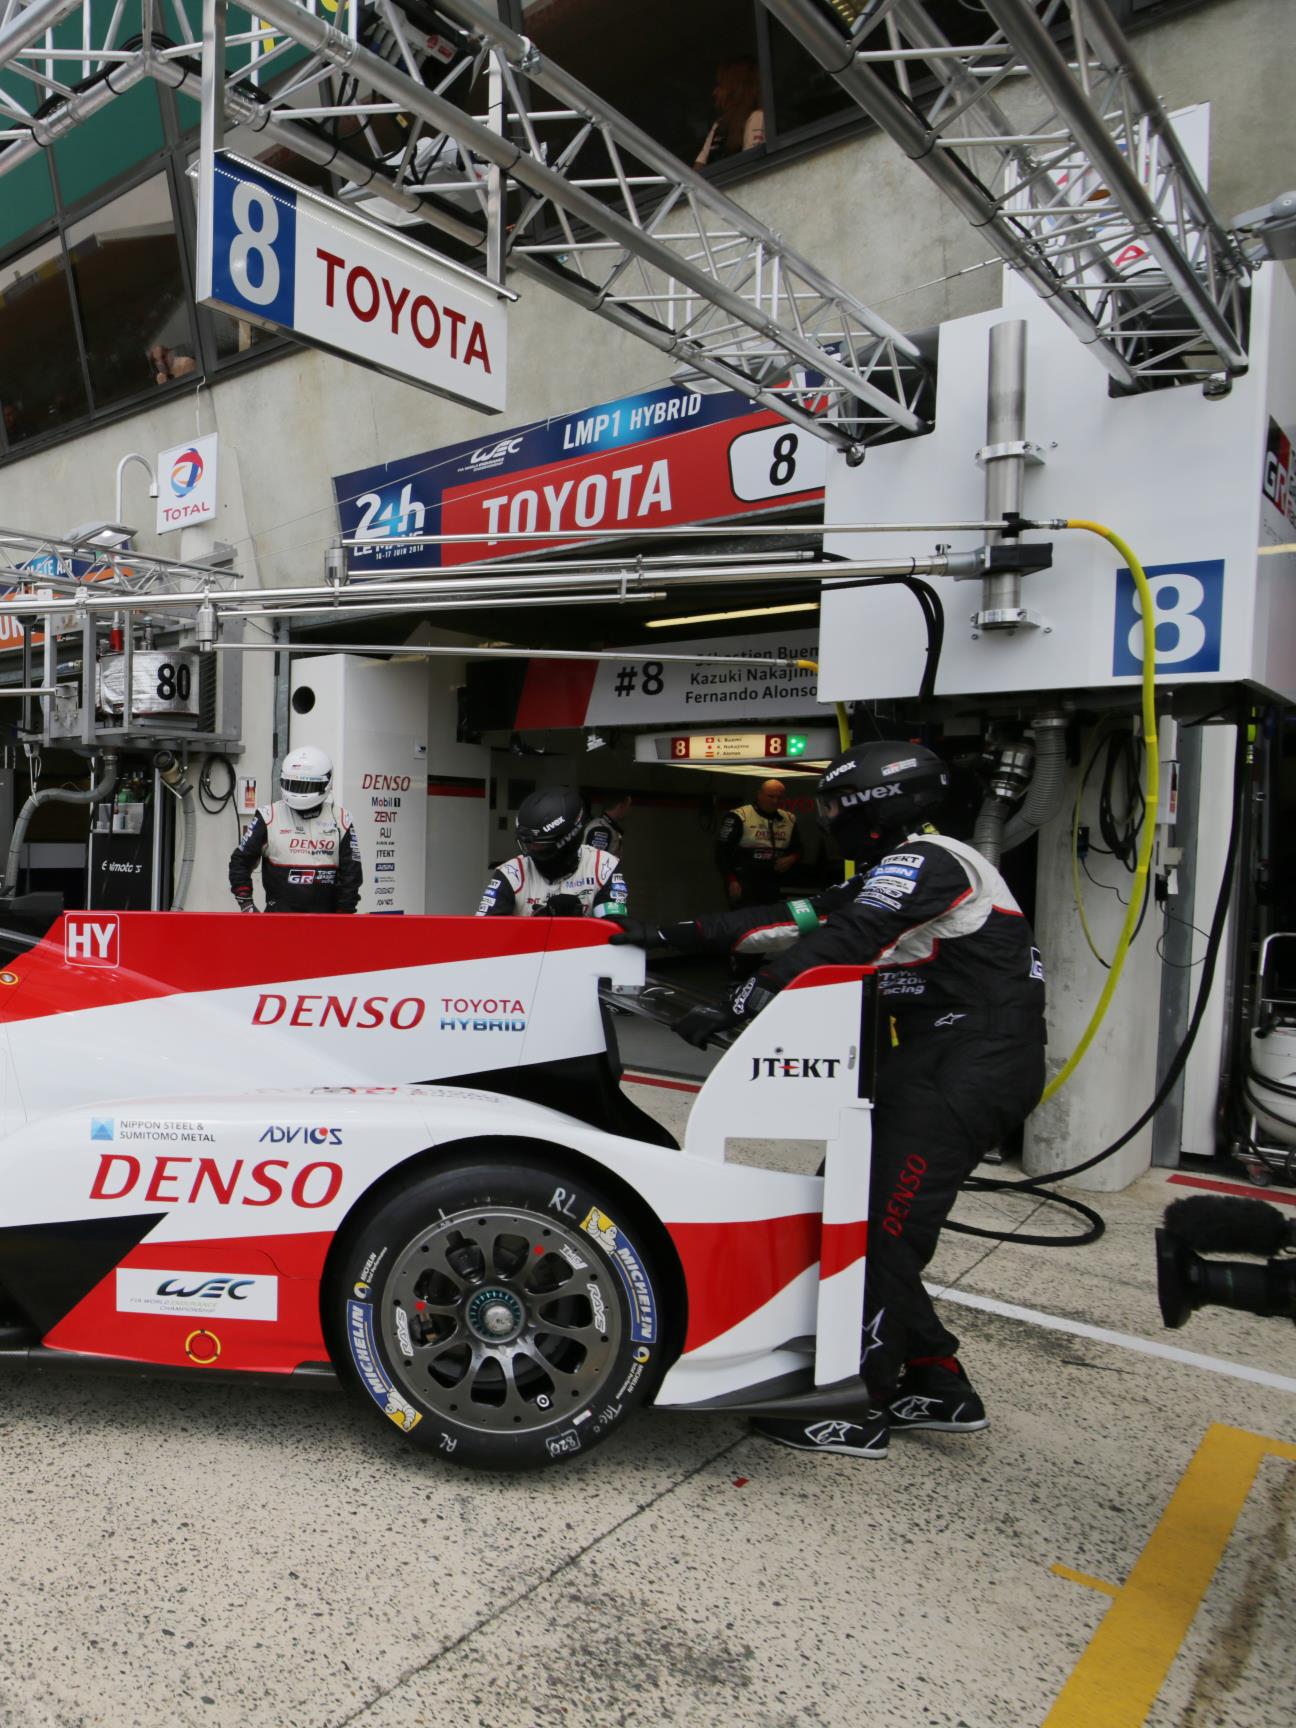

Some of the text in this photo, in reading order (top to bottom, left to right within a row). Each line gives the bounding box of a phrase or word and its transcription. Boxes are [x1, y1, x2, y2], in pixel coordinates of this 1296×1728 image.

[229, 181, 280, 306] 8
[316, 248, 492, 374] TOYOTA
[563, 393, 702, 451] LMP1 HYBRID
[768, 432, 799, 487] 8
[163, 502, 211, 523] TOTAL
[482, 459, 673, 546] TOYOTA
[1128, 573, 1206, 665] 8
[157, 663, 191, 701] 80
[614, 661, 664, 698] #8
[690, 664, 818, 686] Kazuki Nakajim
[685, 685, 818, 704] Fernando Alonso
[676, 740, 686, 756] 8
[769, 738, 781, 754] 8
[362, 773, 411, 792] DENSO
[826, 761, 856, 782] uvex
[371, 797, 393, 807] Mobil
[841, 782, 903, 807] uvex
[374, 812, 397, 823] ZENT
[543, 816, 565, 832] uvex
[289, 839, 335, 850] DENSO
[68, 923, 116, 958] HY
[251, 994, 425, 1030] DENSO
[442, 999, 525, 1014] TOYOTA
[440, 1018, 526, 1032] HYBRID
[750, 1057, 841, 1081] JTEKT
[120, 1120, 204, 1131] NIPPON STEEL &
[120, 1130, 216, 1142] SUMITOMO METAL
[259, 1126, 343, 1145] ADVICS
[89, 1154, 343, 1208] DENSO
[548, 1187, 577, 1219] RL
[882, 1152, 928, 1238] DENSO
[156, 1277, 256, 1300] WEC
[618, 1247, 653, 1339] MICHELIN
[587, 1283, 607, 1333] RAYS
[396, 1307, 414, 1357] RAYS
[352, 1305, 386, 1394] MICHELIN
[627, 1364, 644, 1393] MICHELIN
